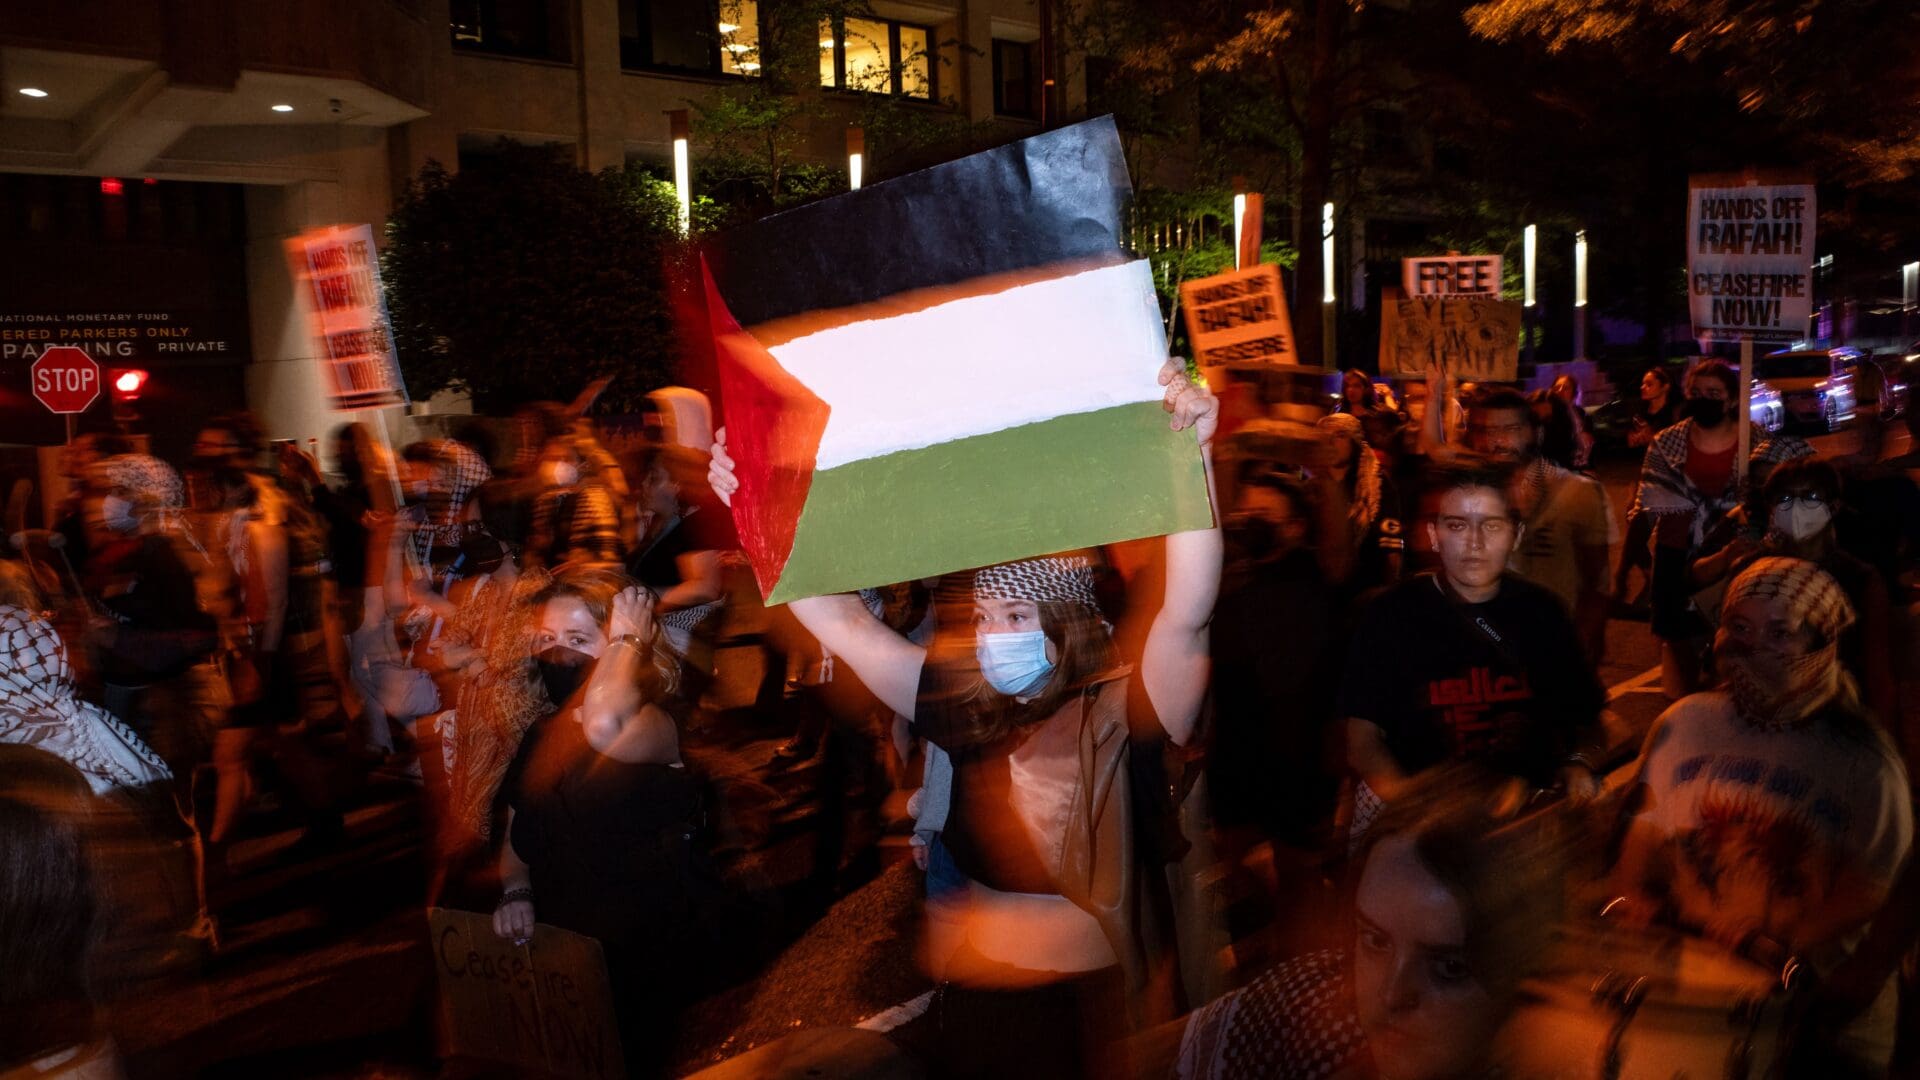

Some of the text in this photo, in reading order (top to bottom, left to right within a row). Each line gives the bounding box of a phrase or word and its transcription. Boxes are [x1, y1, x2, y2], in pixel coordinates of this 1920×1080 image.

[1700, 197, 1805, 220] HANDS OFF
[1699, 222, 1803, 255] RAFAH!
[1416, 260, 1494, 294] FREE
[1694, 273, 1805, 297] CEASEFIRE
[67, 313, 131, 322] MONETARY
[137, 313, 169, 321] FUND
[1711, 299, 1781, 326] NOW!
[60, 328, 138, 339] PARKERS
[147, 327, 189, 338] ONLY
[158, 341, 227, 353] PRIVATE
[37, 368, 95, 392] STOP
[1475, 616, 1502, 642] Canon
